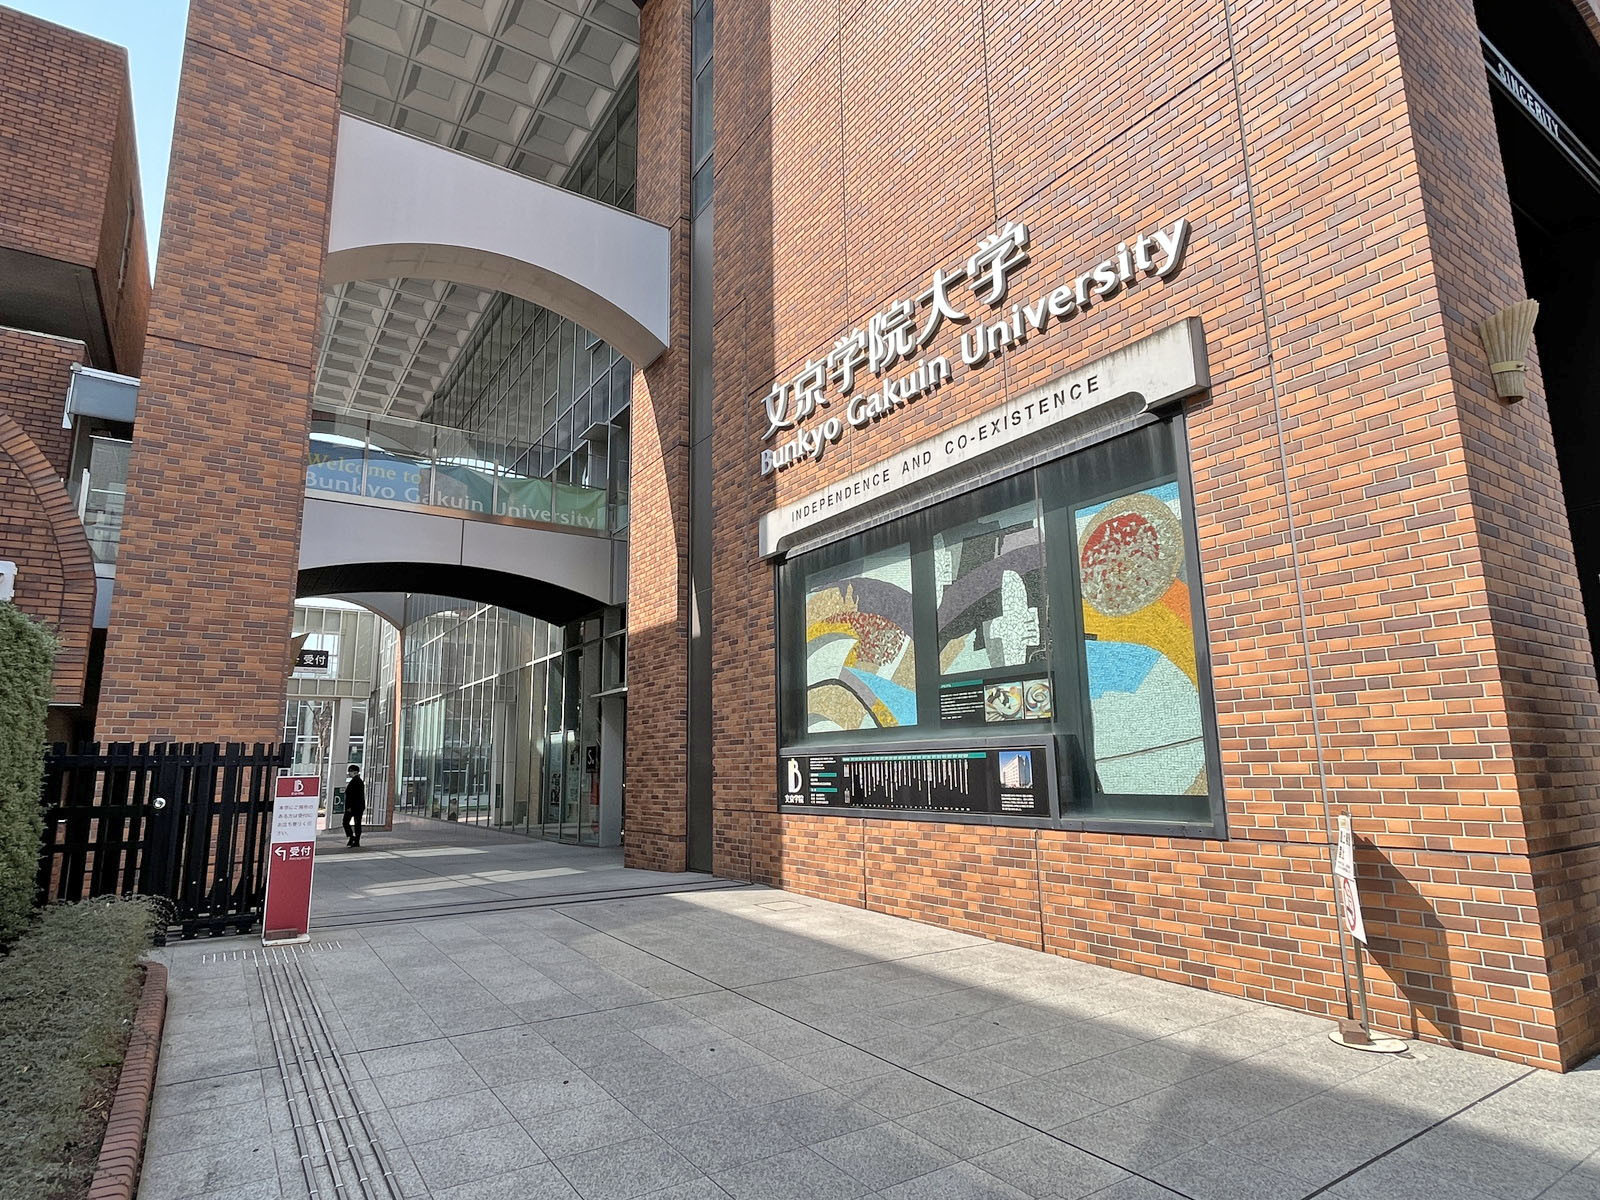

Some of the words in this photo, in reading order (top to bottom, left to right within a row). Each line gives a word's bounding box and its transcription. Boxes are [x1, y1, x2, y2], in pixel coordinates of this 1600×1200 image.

[1498, 62, 1559, 138] SINCERITY
[761, 220, 1029, 439] 文京学院大学
[761, 417, 842, 475] Bunkyo
[847, 355, 951, 426] Gakuin
[960, 218, 1191, 364] University
[308, 452, 397, 480] Welcome
[404, 471, 422, 484] to
[791, 469, 890, 522] INDEPENDENCE
[901, 450, 932, 475] AND
[945, 375, 1099, 455] CO-EXISTENCE
[305, 471, 396, 499] Bunkyo
[404, 487, 484, 513] Gakuin
[303, 654, 326, 666] 受付
[289, 845, 312, 857] 受付
